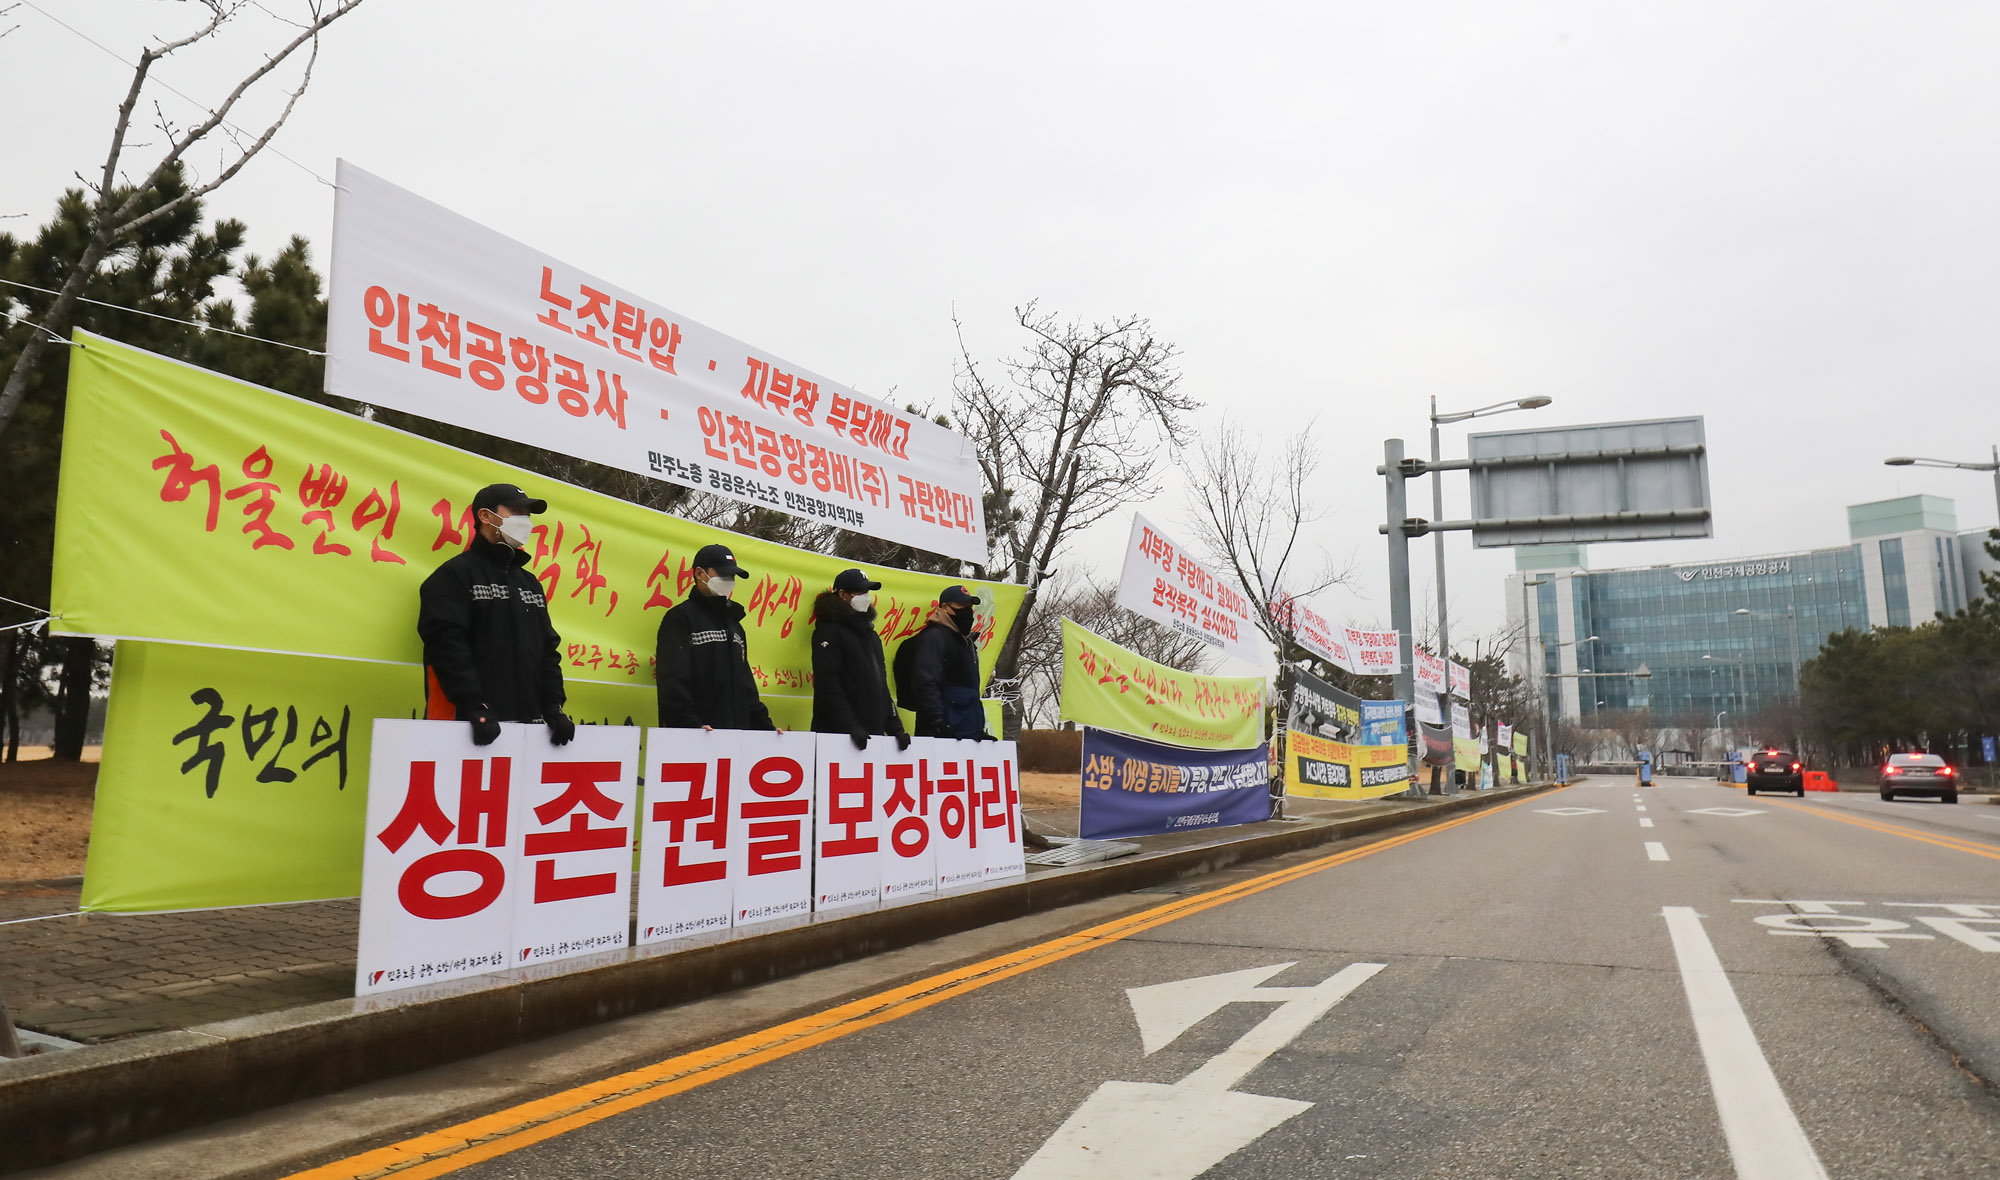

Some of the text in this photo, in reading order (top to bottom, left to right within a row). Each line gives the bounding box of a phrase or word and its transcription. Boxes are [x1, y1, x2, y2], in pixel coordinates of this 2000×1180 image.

[538, 266, 911, 462] 노조탄압 지부장 부당해고
[363, 285, 977, 534] 인천공항공사 인천공항경비(주) 규탄한다!
[648, 451, 865, 527] 민주노총 공공운수노조 인천공항지역지부
[431, 498, 618, 618] 정직화,
[1139, 526, 1174, 573] 지부장
[1177, 553, 1214, 600] 부당해고
[1701, 560, 1791, 580] 인천국제공항공사
[1152, 577, 1198, 624] 원직복직
[1201, 605, 1238, 643] 실시하라
[568, 643, 641, 675] 민주노총
[172, 687, 350, 799] 국민의
